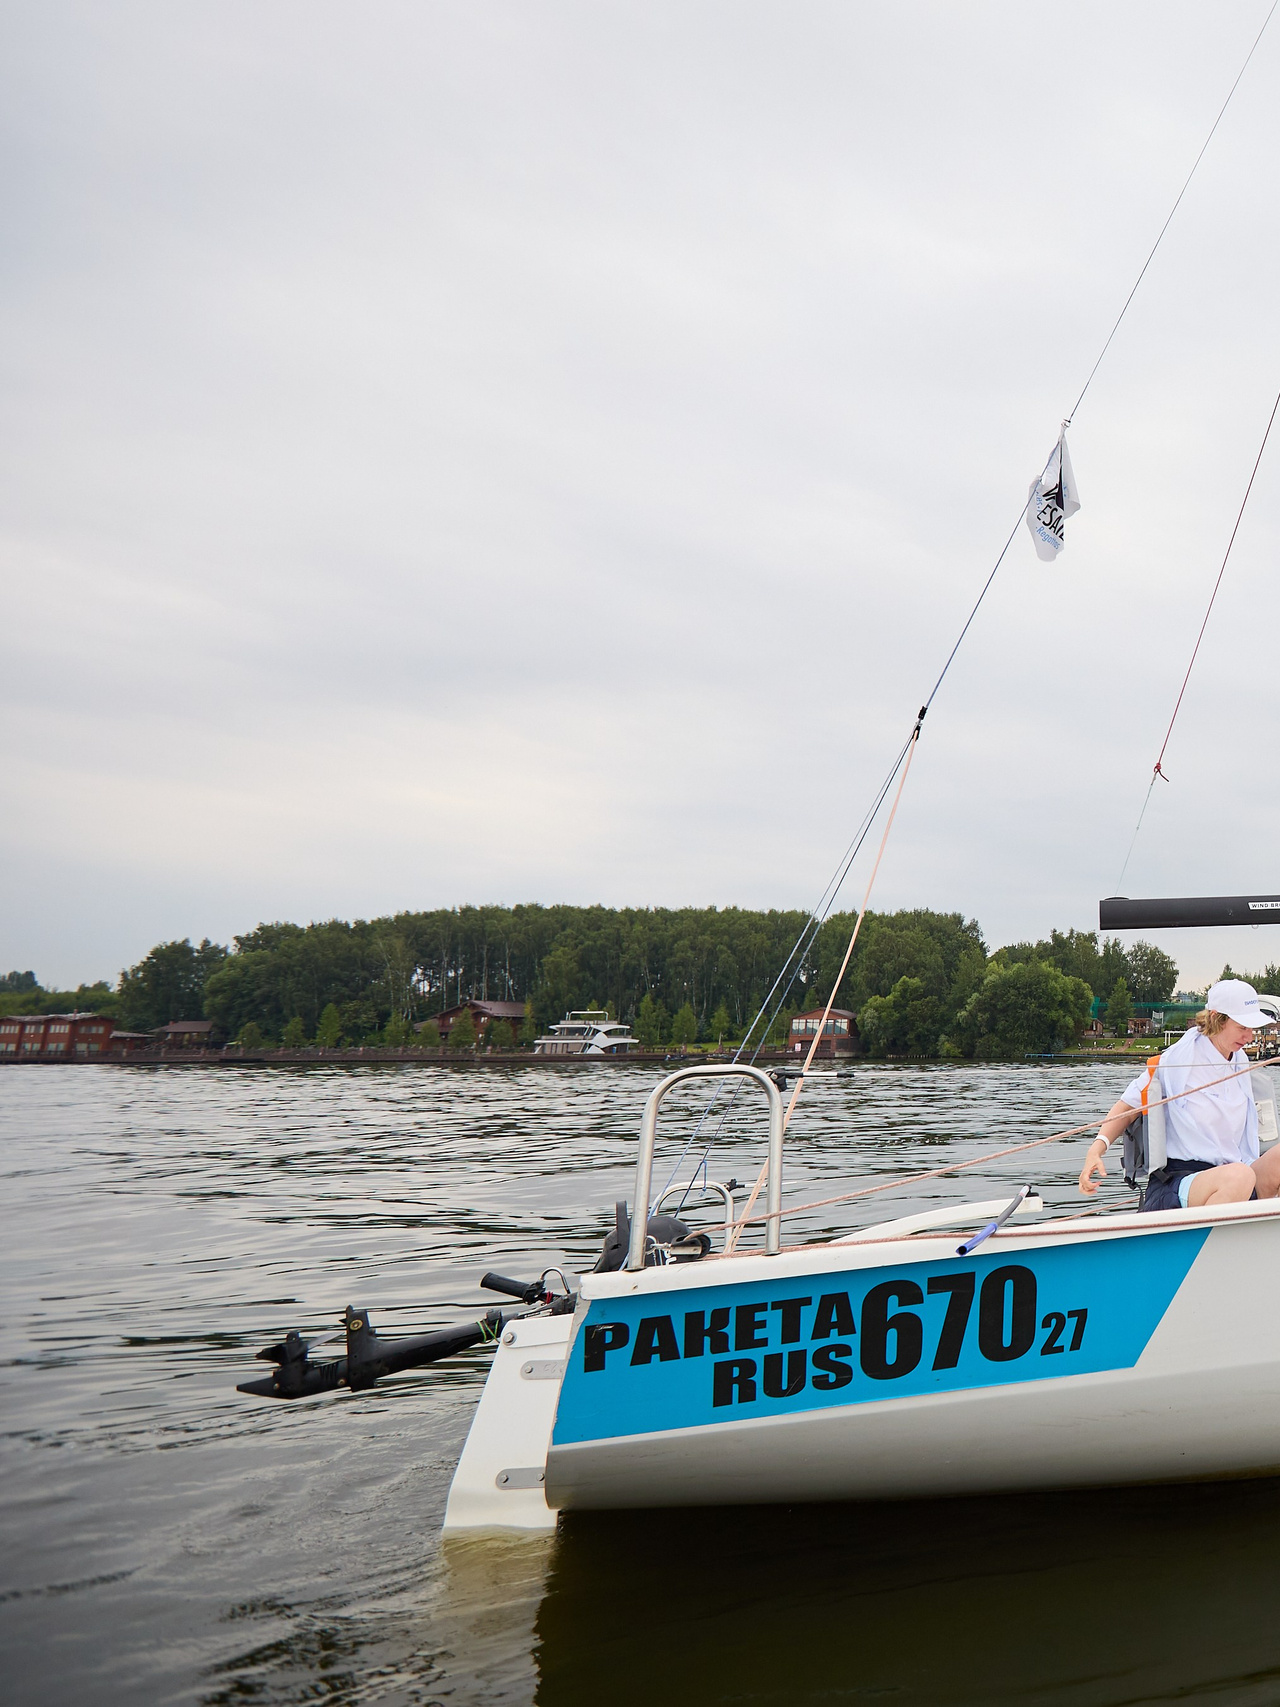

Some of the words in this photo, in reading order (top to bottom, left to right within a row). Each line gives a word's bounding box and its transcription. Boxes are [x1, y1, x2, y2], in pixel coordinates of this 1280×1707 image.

[859, 1264, 1038, 1381] 670
[1040, 1308, 1088, 1357] 27
[712, 1343, 854, 1408] RUS
